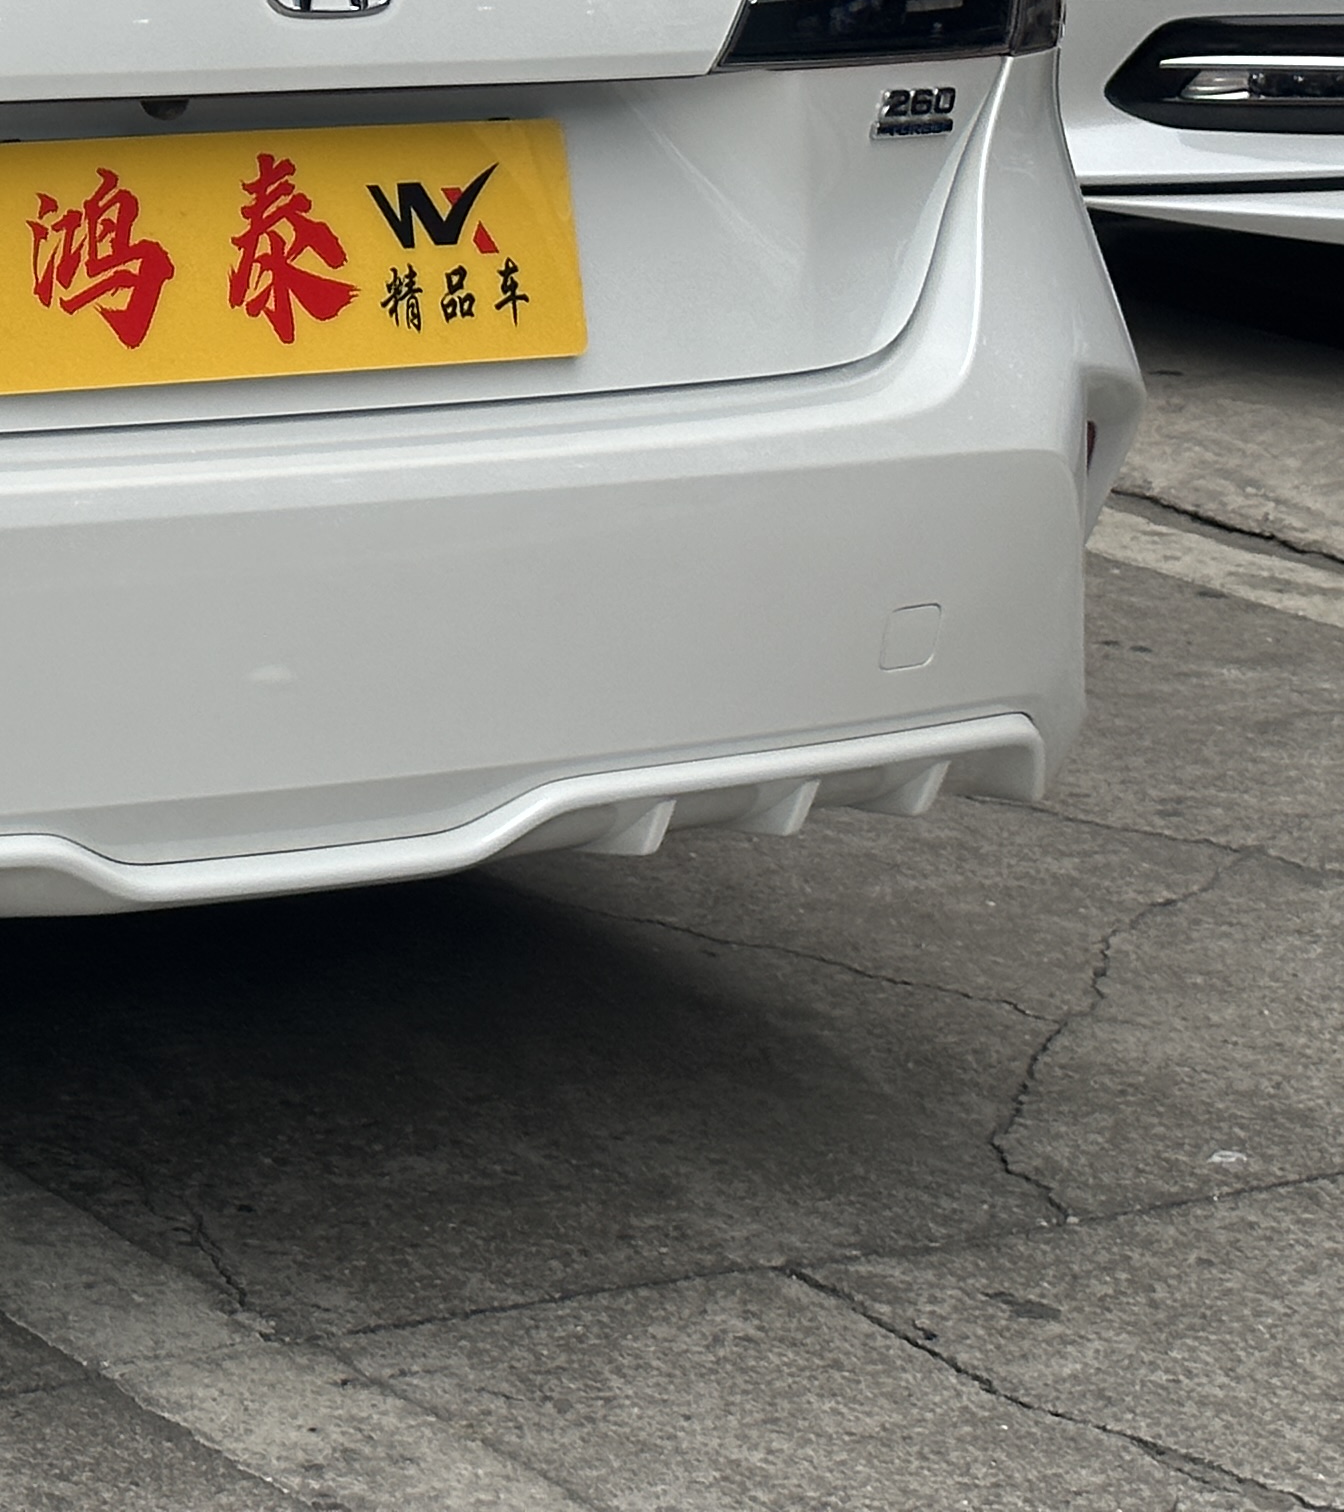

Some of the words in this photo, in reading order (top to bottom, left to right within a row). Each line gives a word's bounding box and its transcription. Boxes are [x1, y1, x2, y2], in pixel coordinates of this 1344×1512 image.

[882, 87, 957, 117] 260
[27, 152, 362, 351] 鸿泰
[379, 257, 531, 336] 精品车
